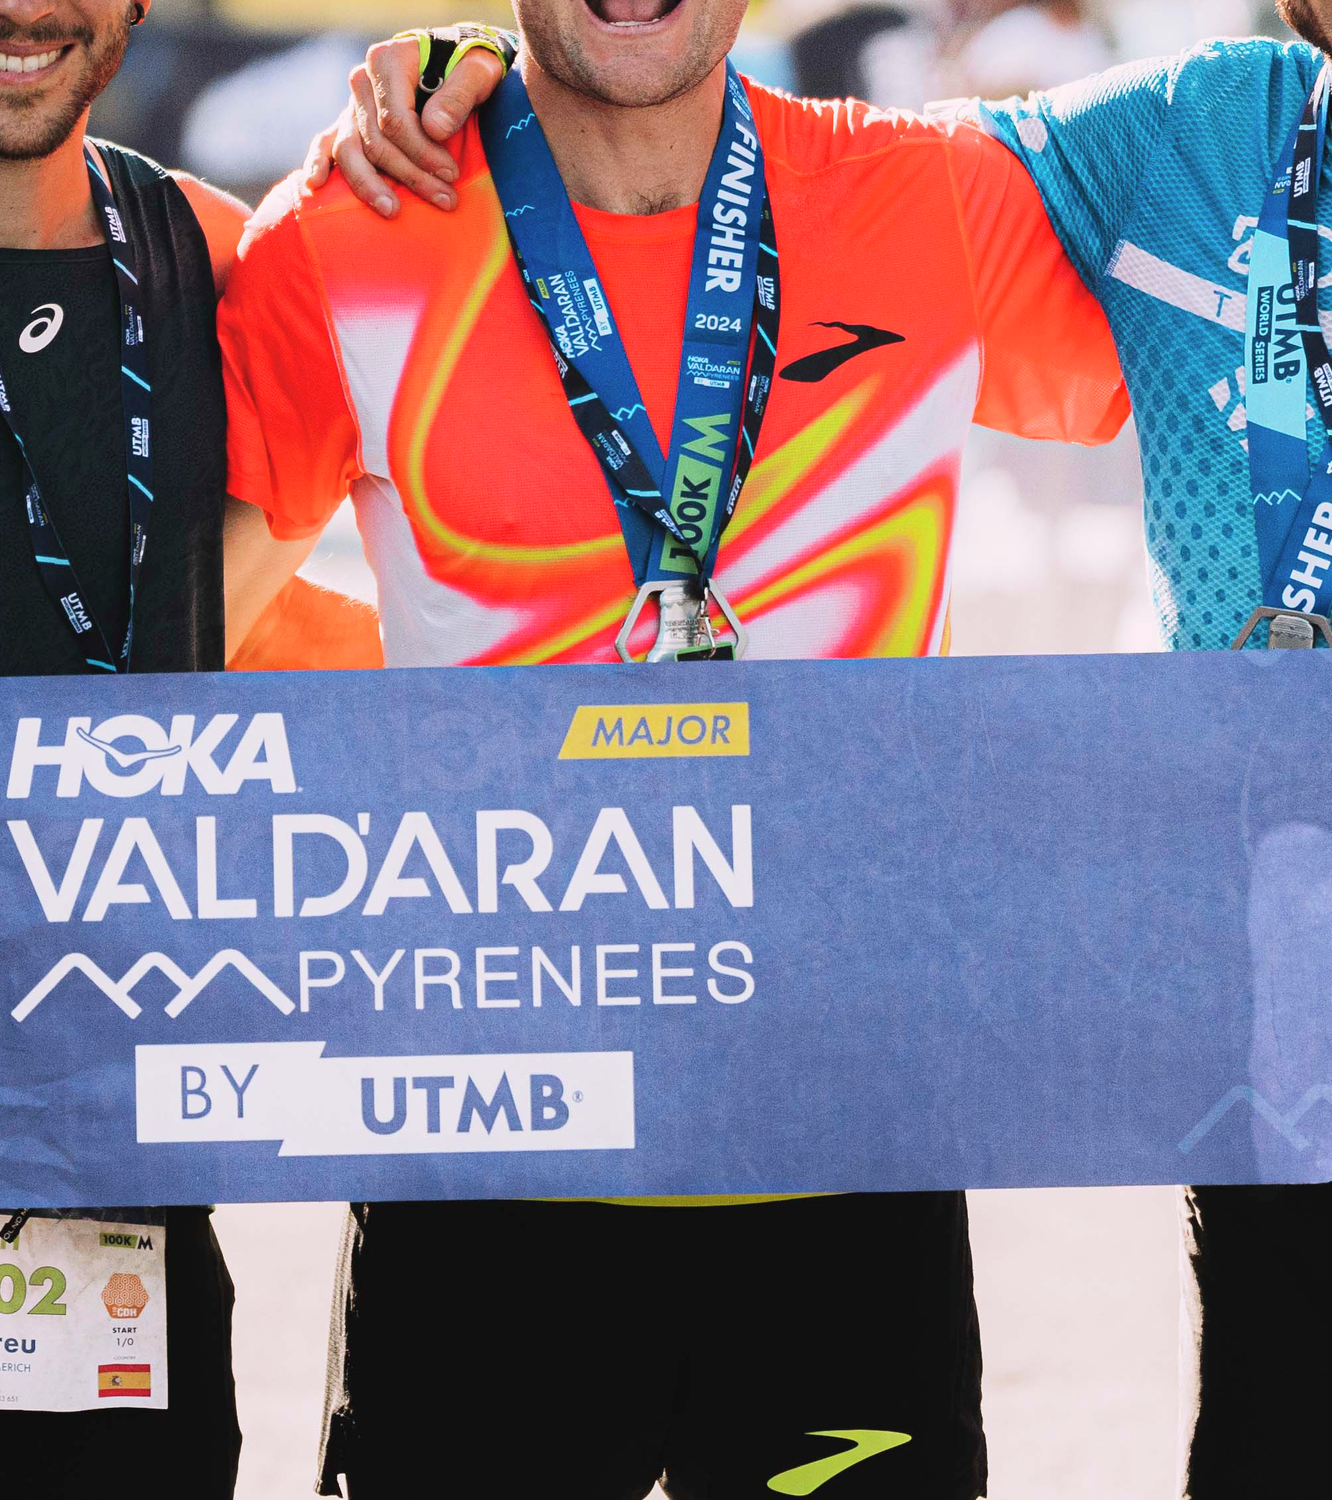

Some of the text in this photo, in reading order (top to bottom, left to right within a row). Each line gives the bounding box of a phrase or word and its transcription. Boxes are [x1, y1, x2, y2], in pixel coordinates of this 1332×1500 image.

[1294, 160, 1305, 198] UTMB
[105, 206, 121, 242] UTMB
[705, 121, 758, 293] FINISHER
[564, 270, 592, 322] PYRENEES
[589, 285, 604, 311] UTMB
[762, 277, 776, 311] UTMB
[554, 324, 576, 359] HOKA
[695, 314, 741, 332] 2024
[1254, 289, 1271, 382] WORLD SERIES
[131, 417, 142, 457] UTMB
[669, 413, 732, 559] 100K M
[67, 592, 93, 632] UTMB
[592, 714, 731, 747] MAJOR
[6, 712, 300, 799] HOKA
[299, 940, 756, 1013] PYRENEES
[180, 1064, 260, 1119] BY
[102, 1233, 154, 1250] 100K M
[117, 1307, 137, 1318] CDH
[116, 1337, 135, 1347] 1/0
